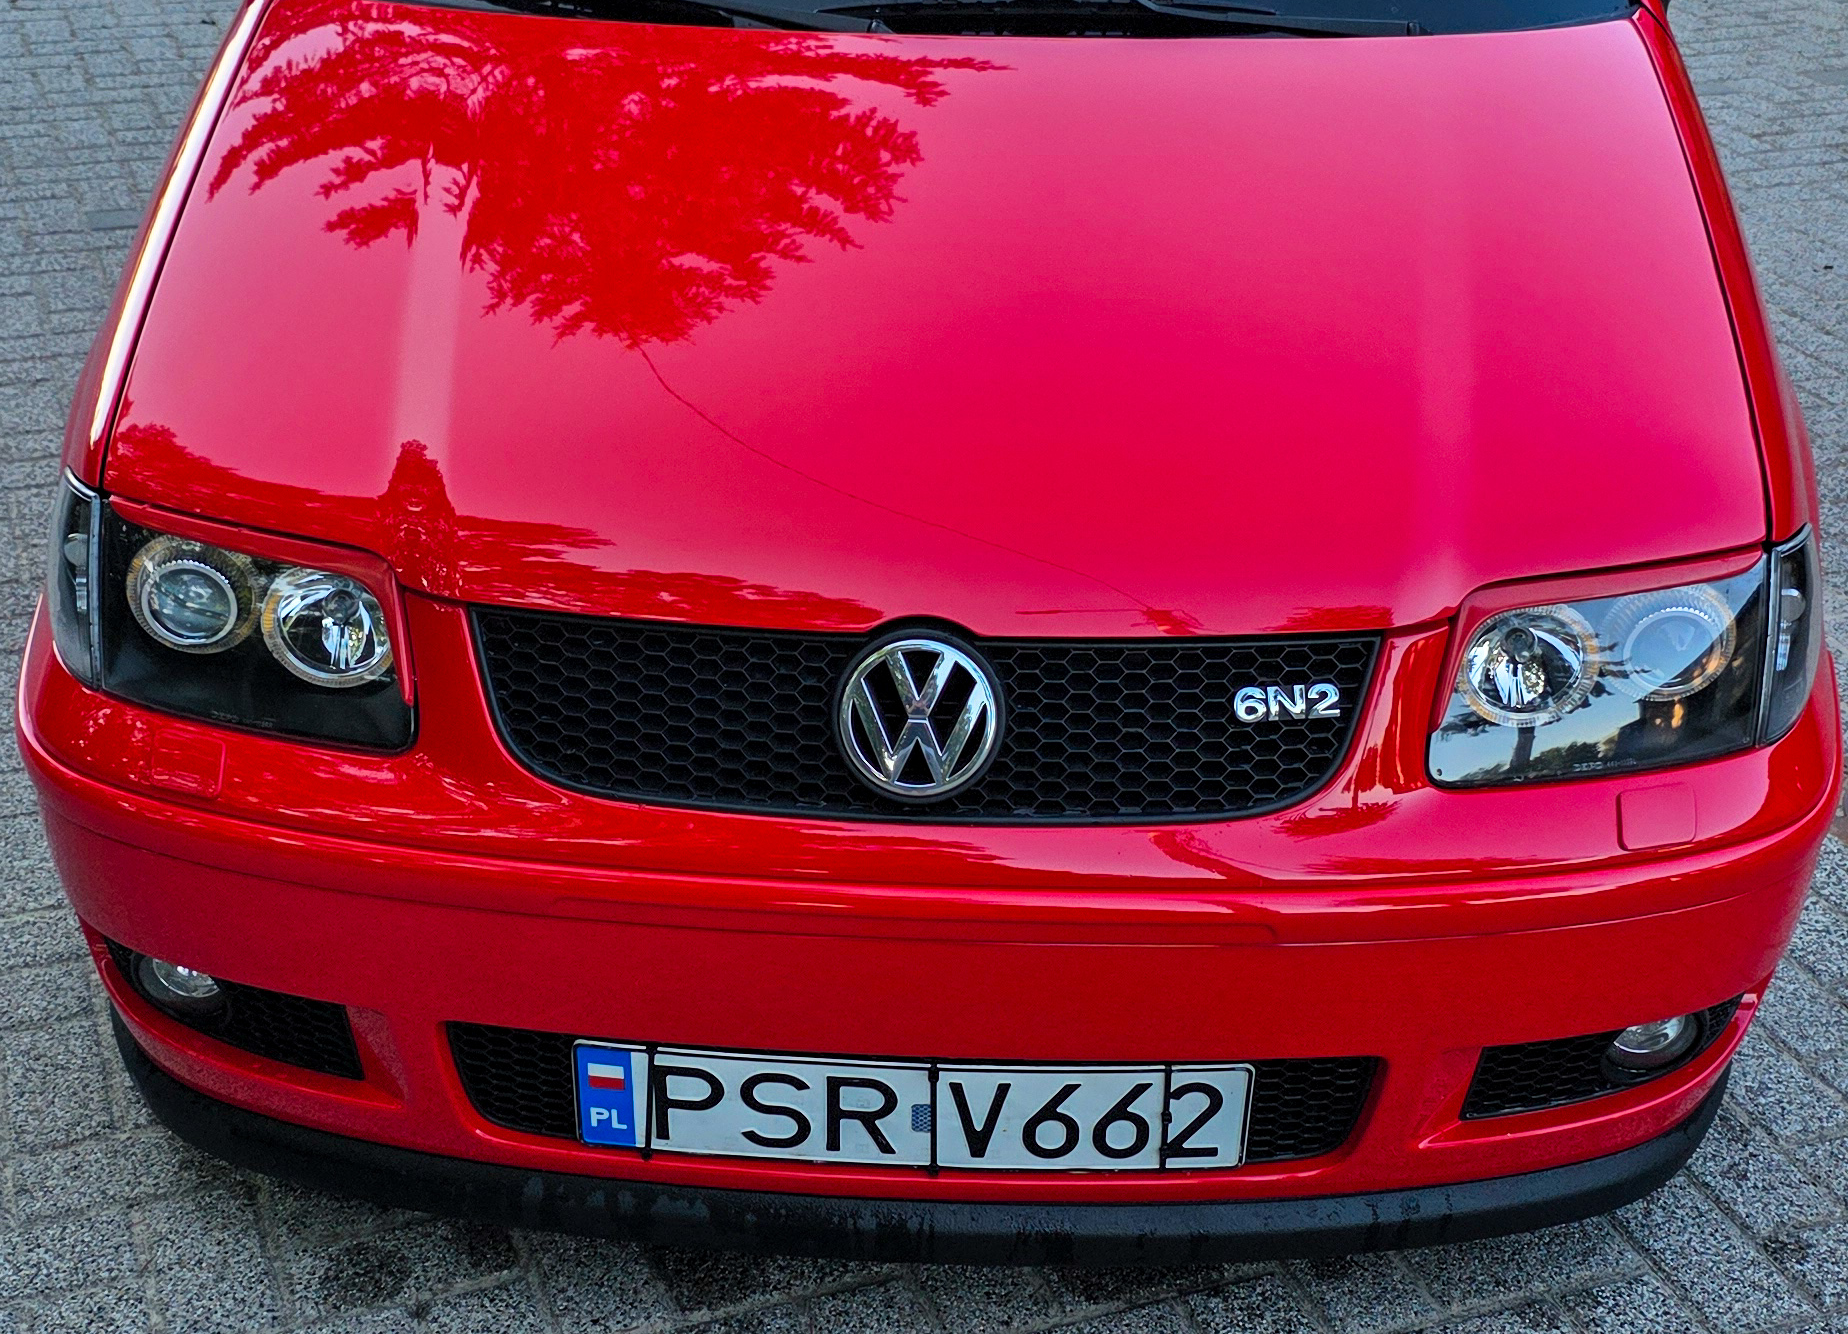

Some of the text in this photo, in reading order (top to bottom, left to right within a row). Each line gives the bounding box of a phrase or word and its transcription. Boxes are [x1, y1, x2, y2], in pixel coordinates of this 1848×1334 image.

[840, 640, 996, 796] VW
[1234, 683, 1340, 723] 6N2
[589, 1107, 627, 1130] PL
[652, 1066, 1224, 1159] PSR V662
